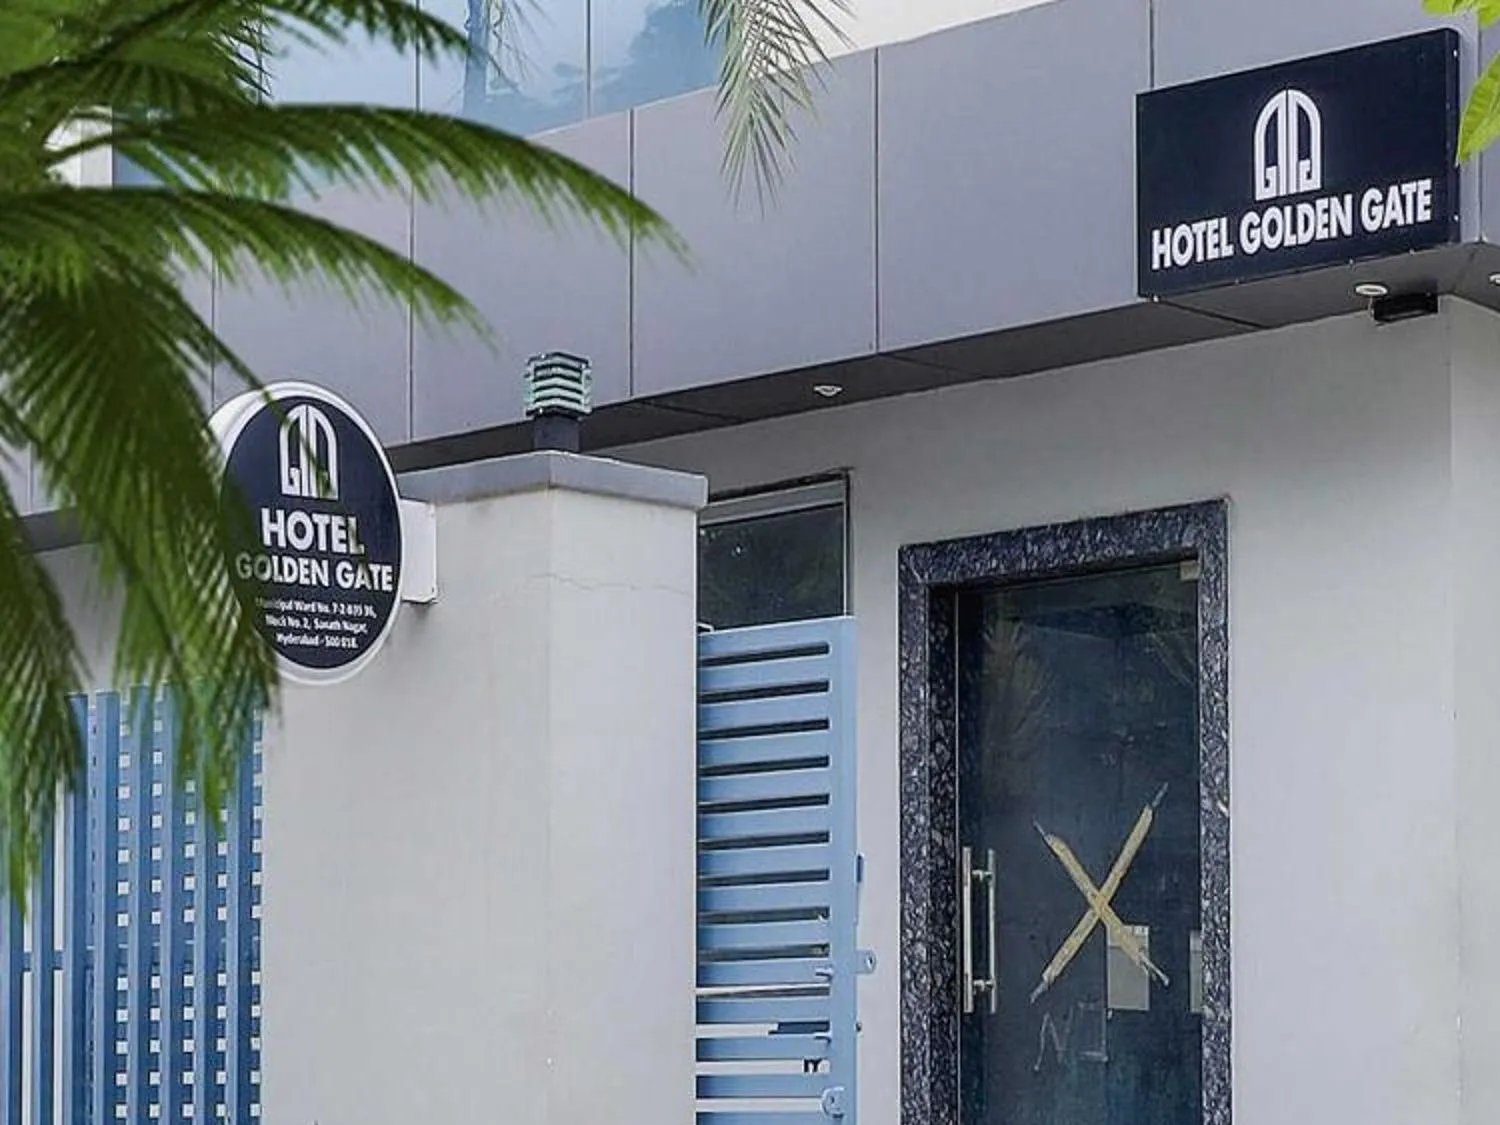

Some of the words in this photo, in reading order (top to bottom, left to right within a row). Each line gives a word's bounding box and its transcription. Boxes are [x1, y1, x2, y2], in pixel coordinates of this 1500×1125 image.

[1151, 216, 1234, 270] HOTEL
[1240, 194, 1353, 255] GOLDEN
[1361, 178, 1433, 232] GATE
[261, 508, 365, 554] HOTEL
[235, 552, 329, 587] GOLDEN
[335, 561, 394, 591] GATE
